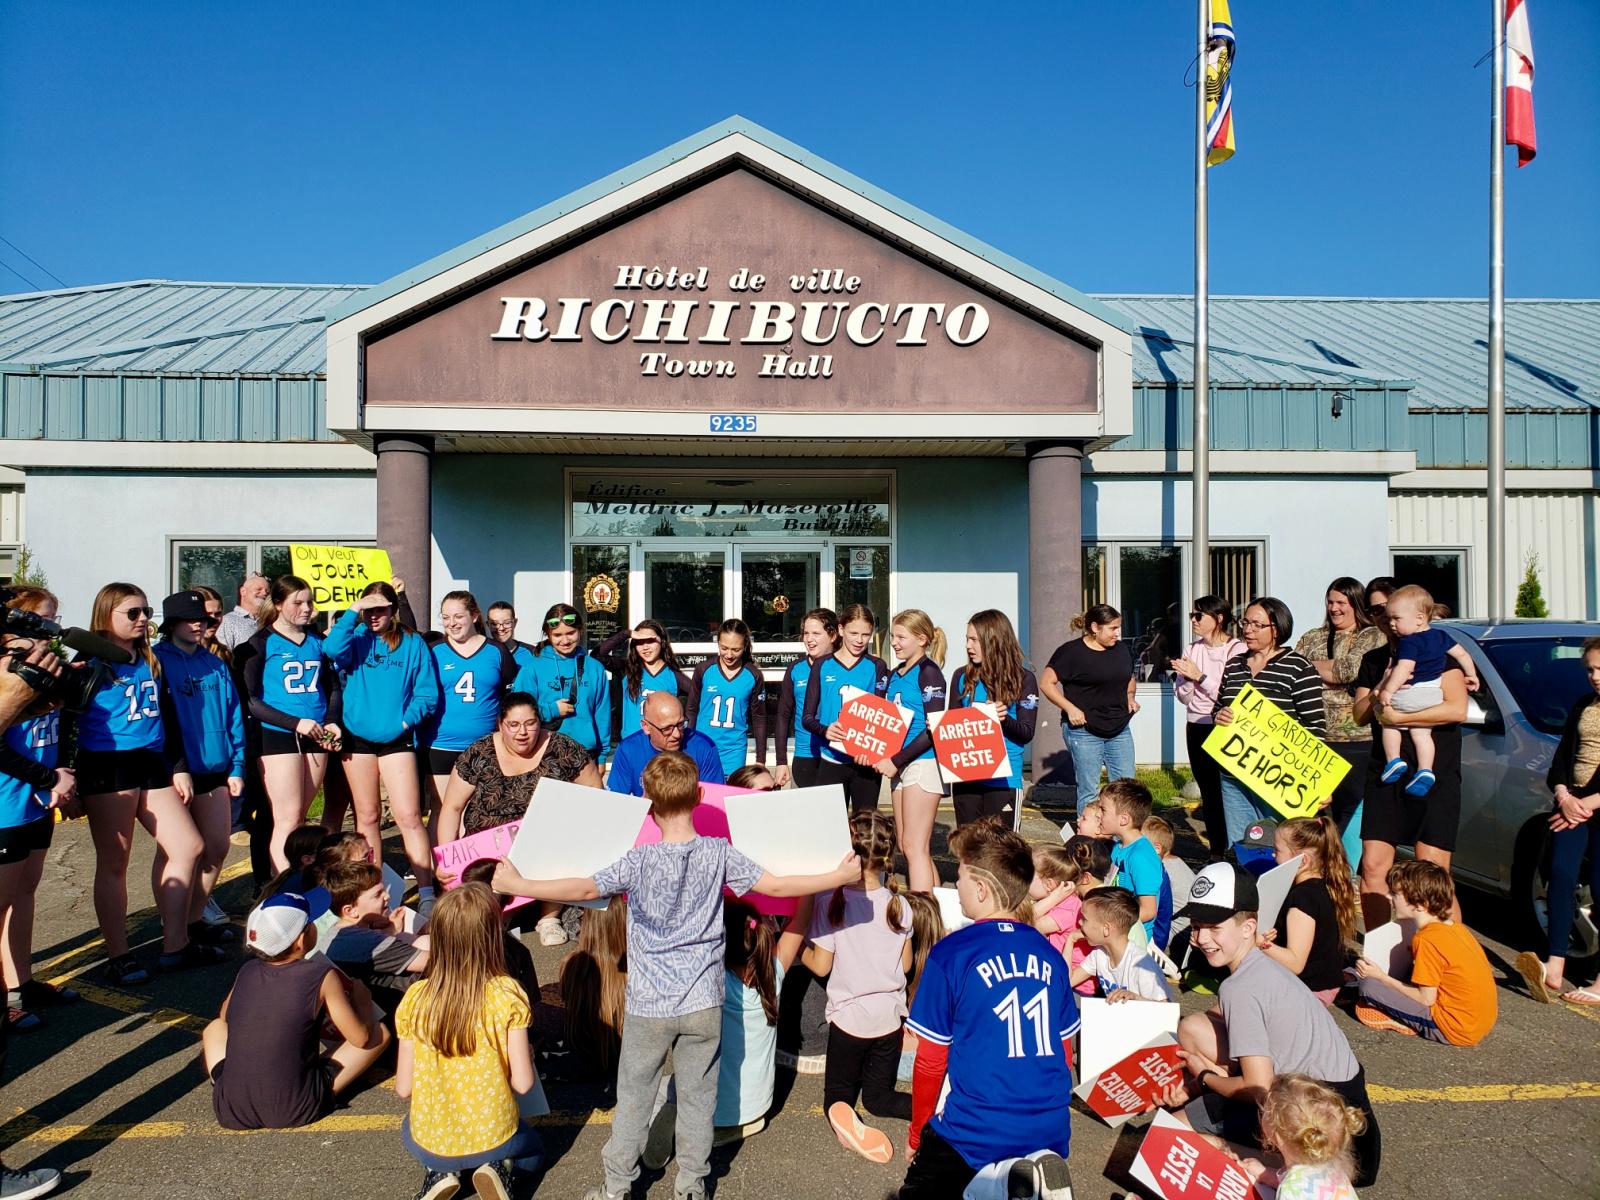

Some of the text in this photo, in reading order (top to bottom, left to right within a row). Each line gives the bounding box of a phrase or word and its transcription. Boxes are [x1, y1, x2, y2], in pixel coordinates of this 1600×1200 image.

[613, 265, 861, 292] Hôtel de ville
[490, 296, 990, 346] RICHIBUCTO
[640, 352, 834, 378] Town Hall
[711, 415, 756, 431] 9235
[585, 499, 877, 518] Meldric J. Mazerolle
[782, 517, 874, 532] Building
[296, 546, 318, 561] ON
[310, 563, 368, 581] JOUER
[282, 660, 322, 693] 27
[454, 671, 476, 703] 4
[125, 680, 160, 721] 13
[709, 694, 736, 729] 11
[847, 701, 903, 734] ARRÊTEZ
[864, 723, 876, 735] LA
[939, 718, 995, 741] ARRÊTEZ
[1240, 689, 1338, 773] LA GARDERIE
[845, 727, 887, 757] PESTE
[962, 738, 975, 749] LA
[1234, 714, 1322, 789] VEUT JOUER
[950, 749, 995, 769] PESTE
[976, 952, 1052, 989] PILLAR
[992, 986, 1055, 1058] 11
[1132, 1075, 1148, 1088] LA
[1138, 1051, 1178, 1088] PESTE
[1160, 1135, 1200, 1193] PESTE
[1195, 1171, 1215, 1191] LA
